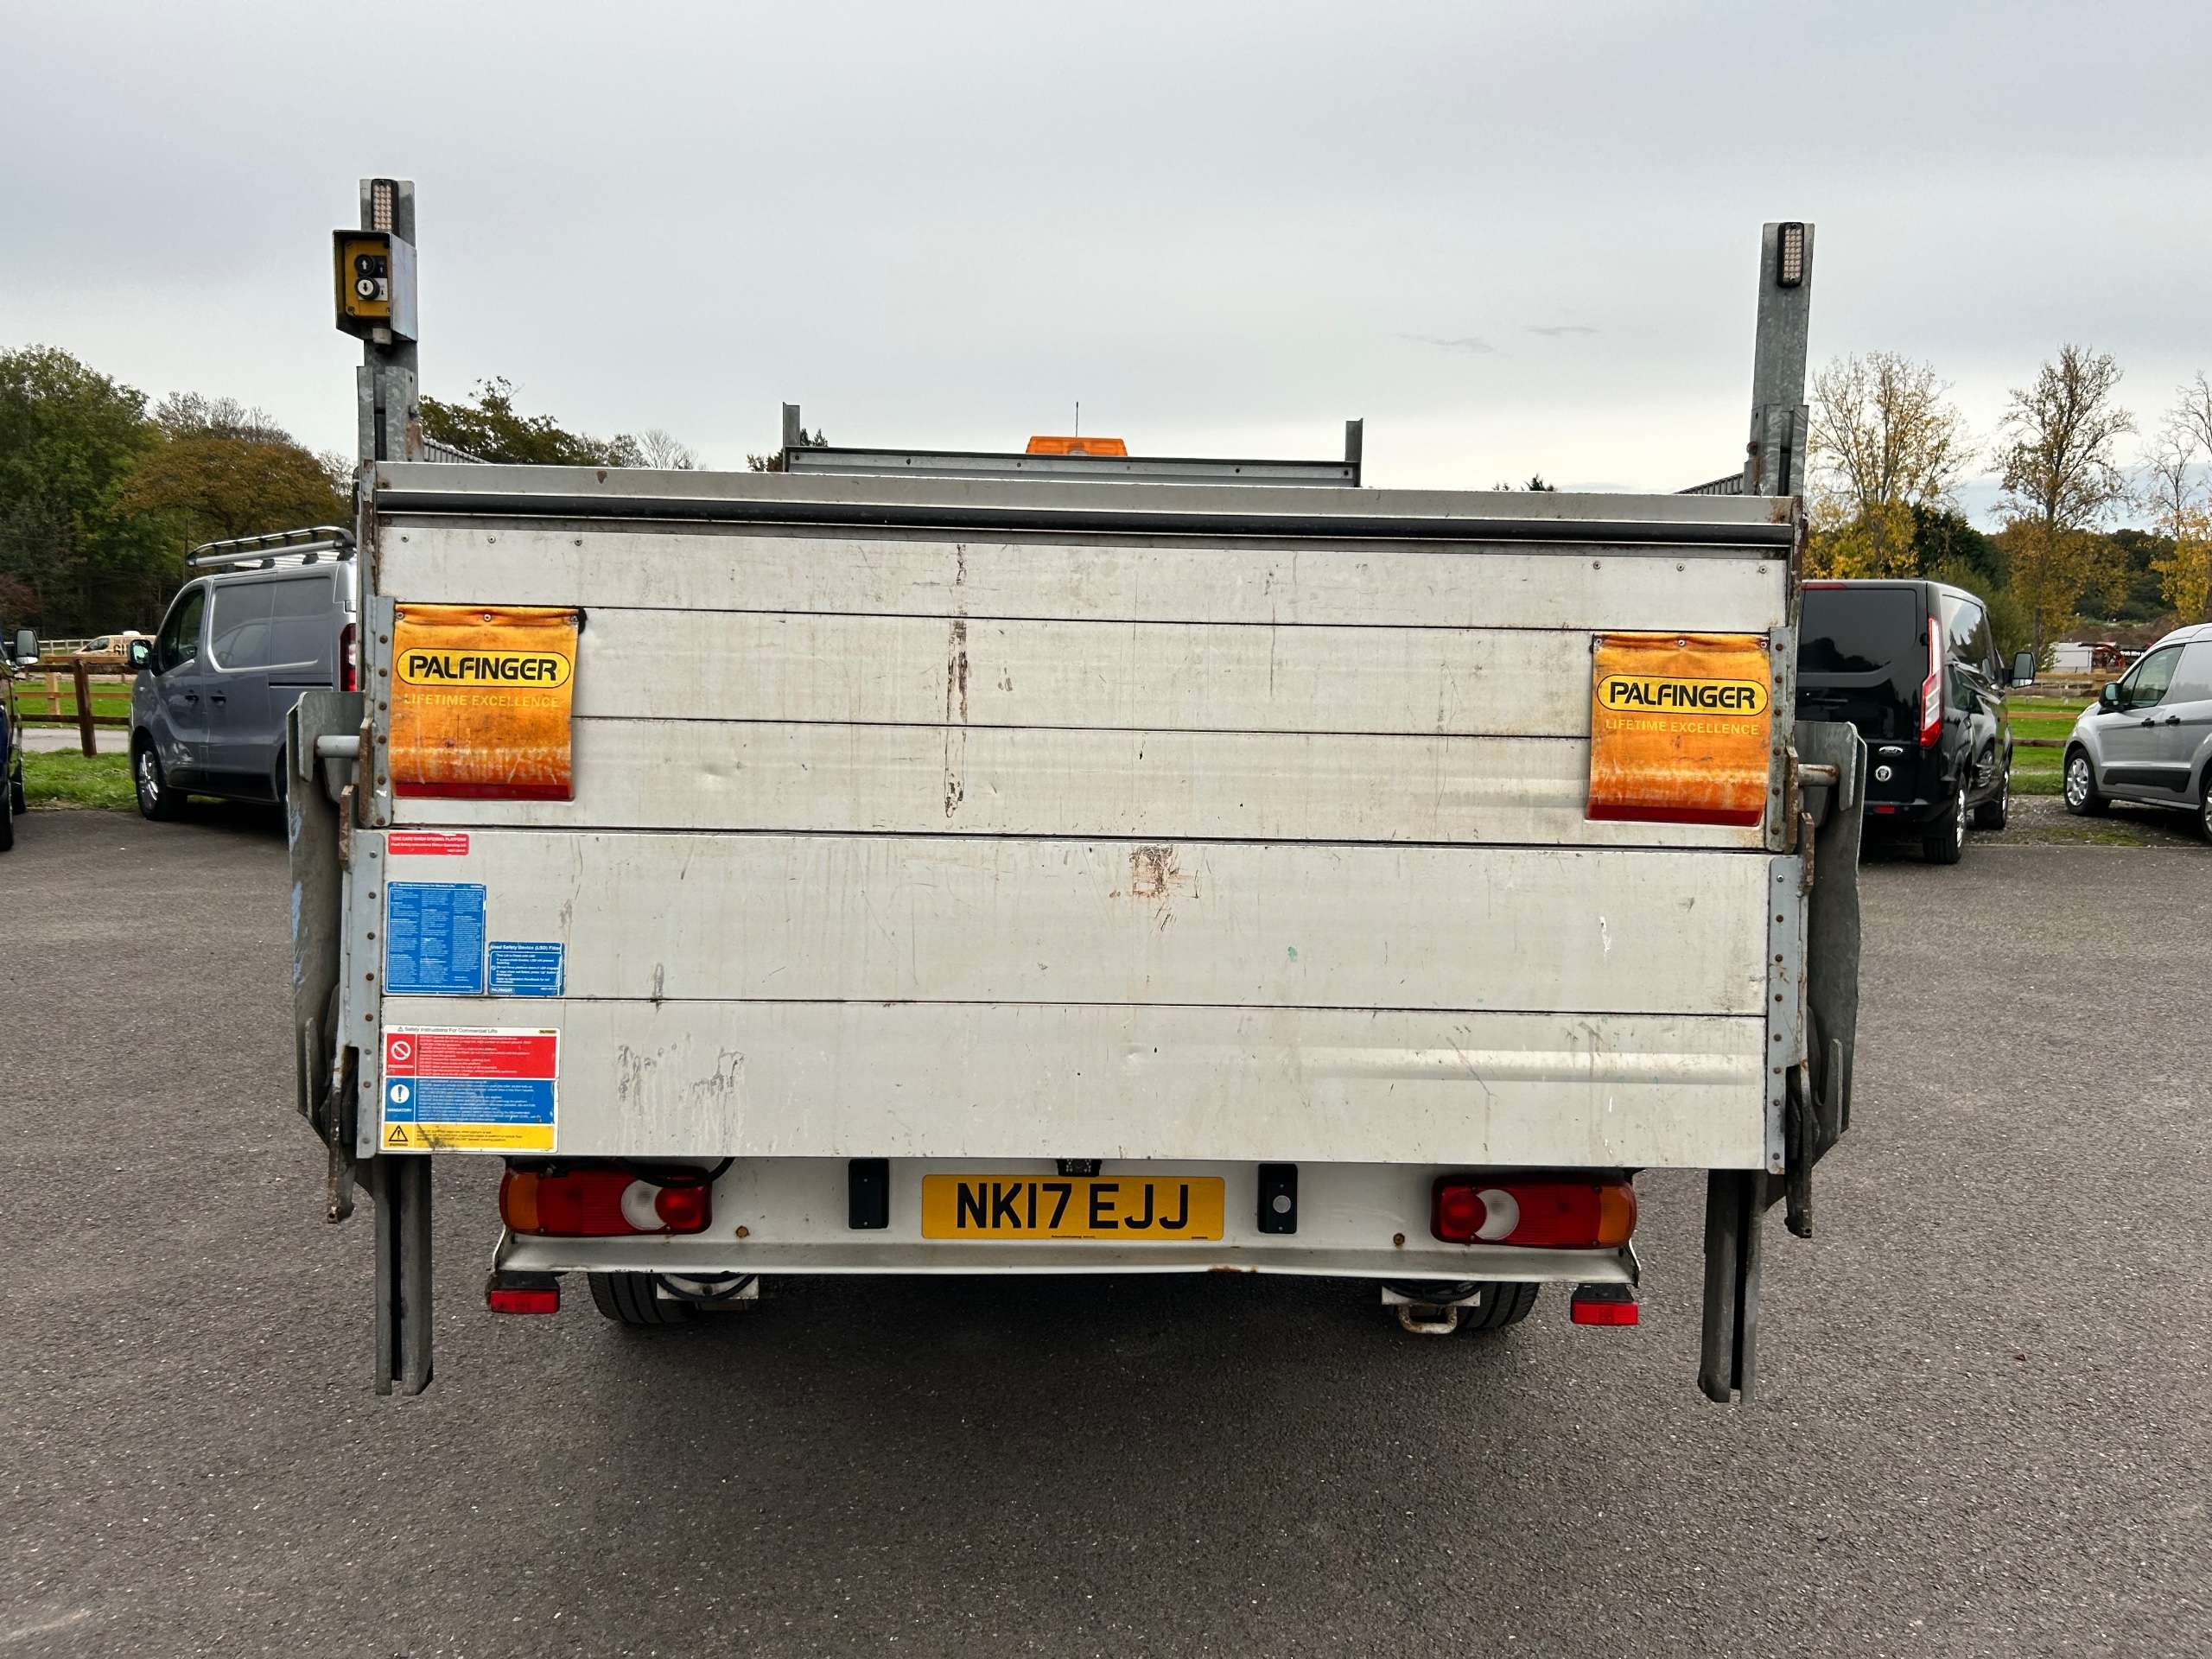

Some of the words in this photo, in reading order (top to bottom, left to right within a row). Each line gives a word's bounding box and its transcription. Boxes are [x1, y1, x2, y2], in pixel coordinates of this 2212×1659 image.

[409, 655, 557, 681] PALFINGER
[404, 694, 467, 706] LIFETIME
[472, 695, 560, 708] EXCELLENCE
[1610, 681, 1756, 709] PALFINGER
[1605, 719, 1667, 731] LIFETIME
[1670, 722, 1759, 734] EXCELLENCE
[957, 1182, 1072, 1230] NK17
[1089, 1183, 1189, 1230] EJJ
